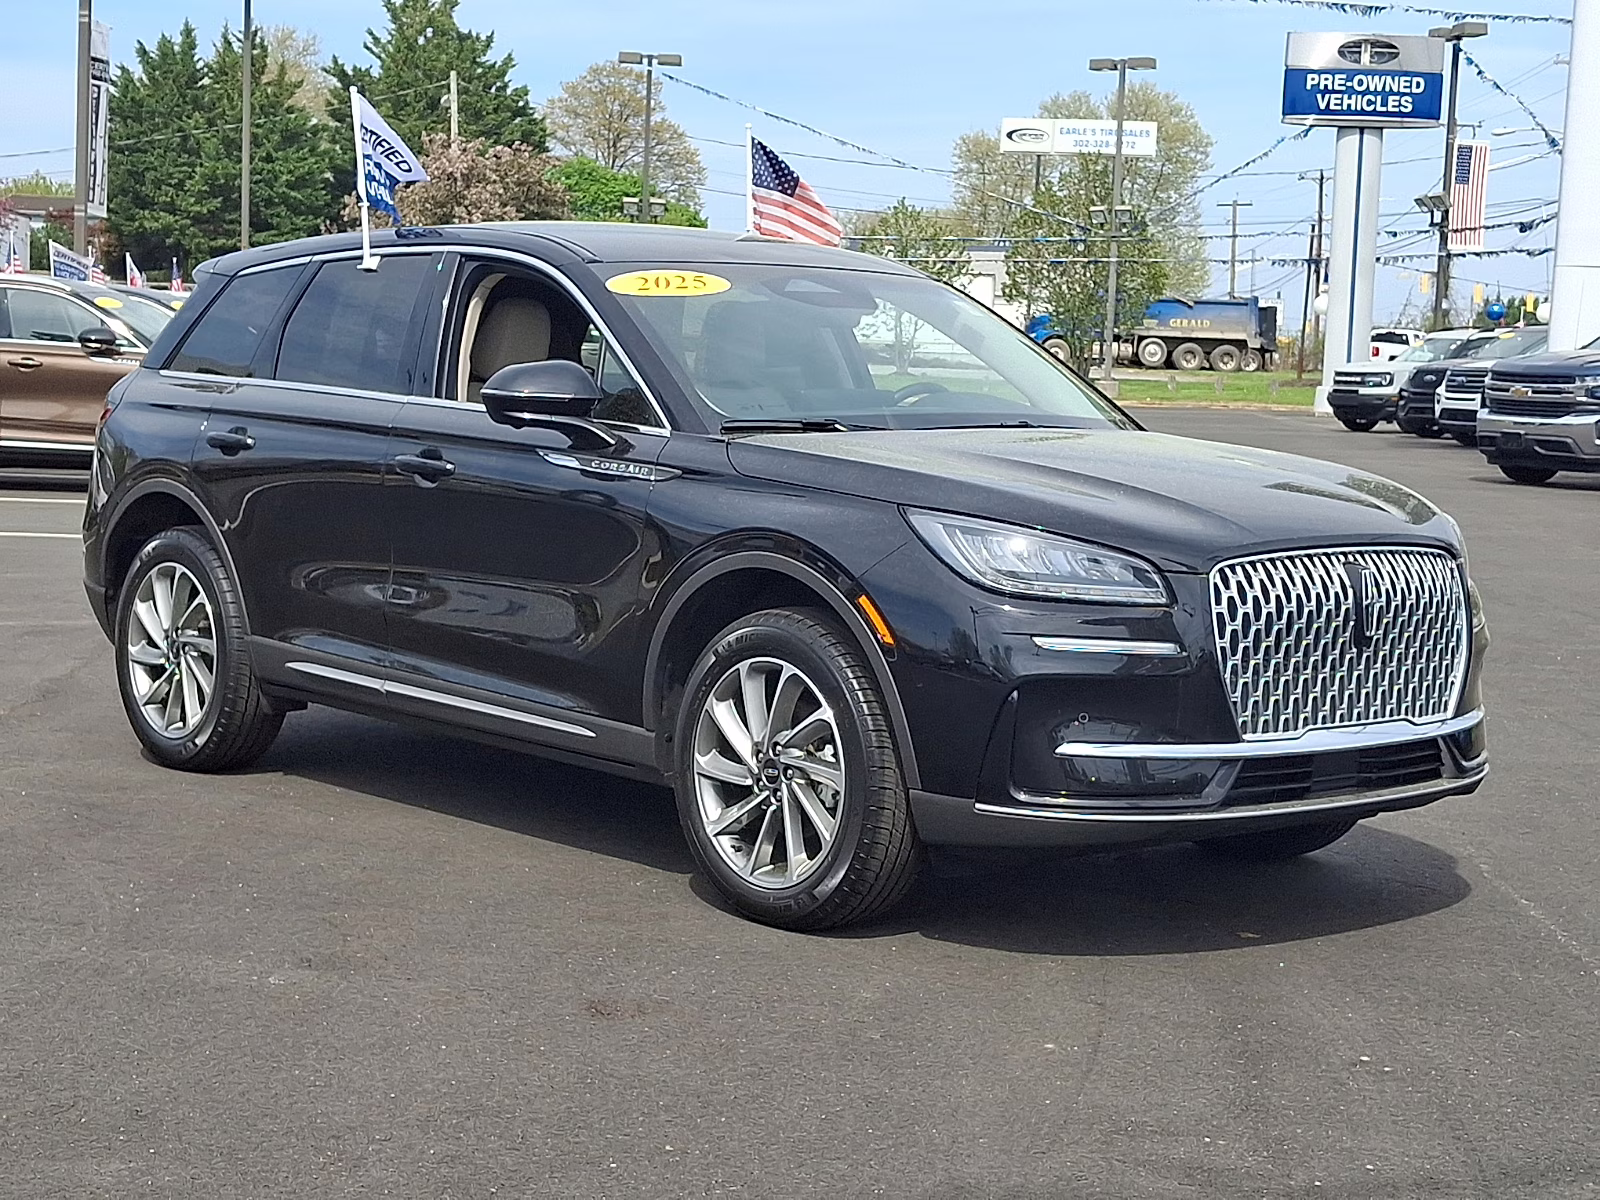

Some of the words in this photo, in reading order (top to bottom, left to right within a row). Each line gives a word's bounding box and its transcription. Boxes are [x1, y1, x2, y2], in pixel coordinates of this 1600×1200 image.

[1305, 73, 1425, 94] PRE-OWNED
[1316, 94, 1413, 113] VEHICLES
[1059, 127, 1097, 137] EARLE'S
[1122, 129, 1151, 138] SALES
[1073, 139, 1136, 149] 302-328-72
[635, 275, 707, 291] 2025
[1169, 318, 1211, 328] GERALD
[591, 459, 649, 476] CORSAIR
